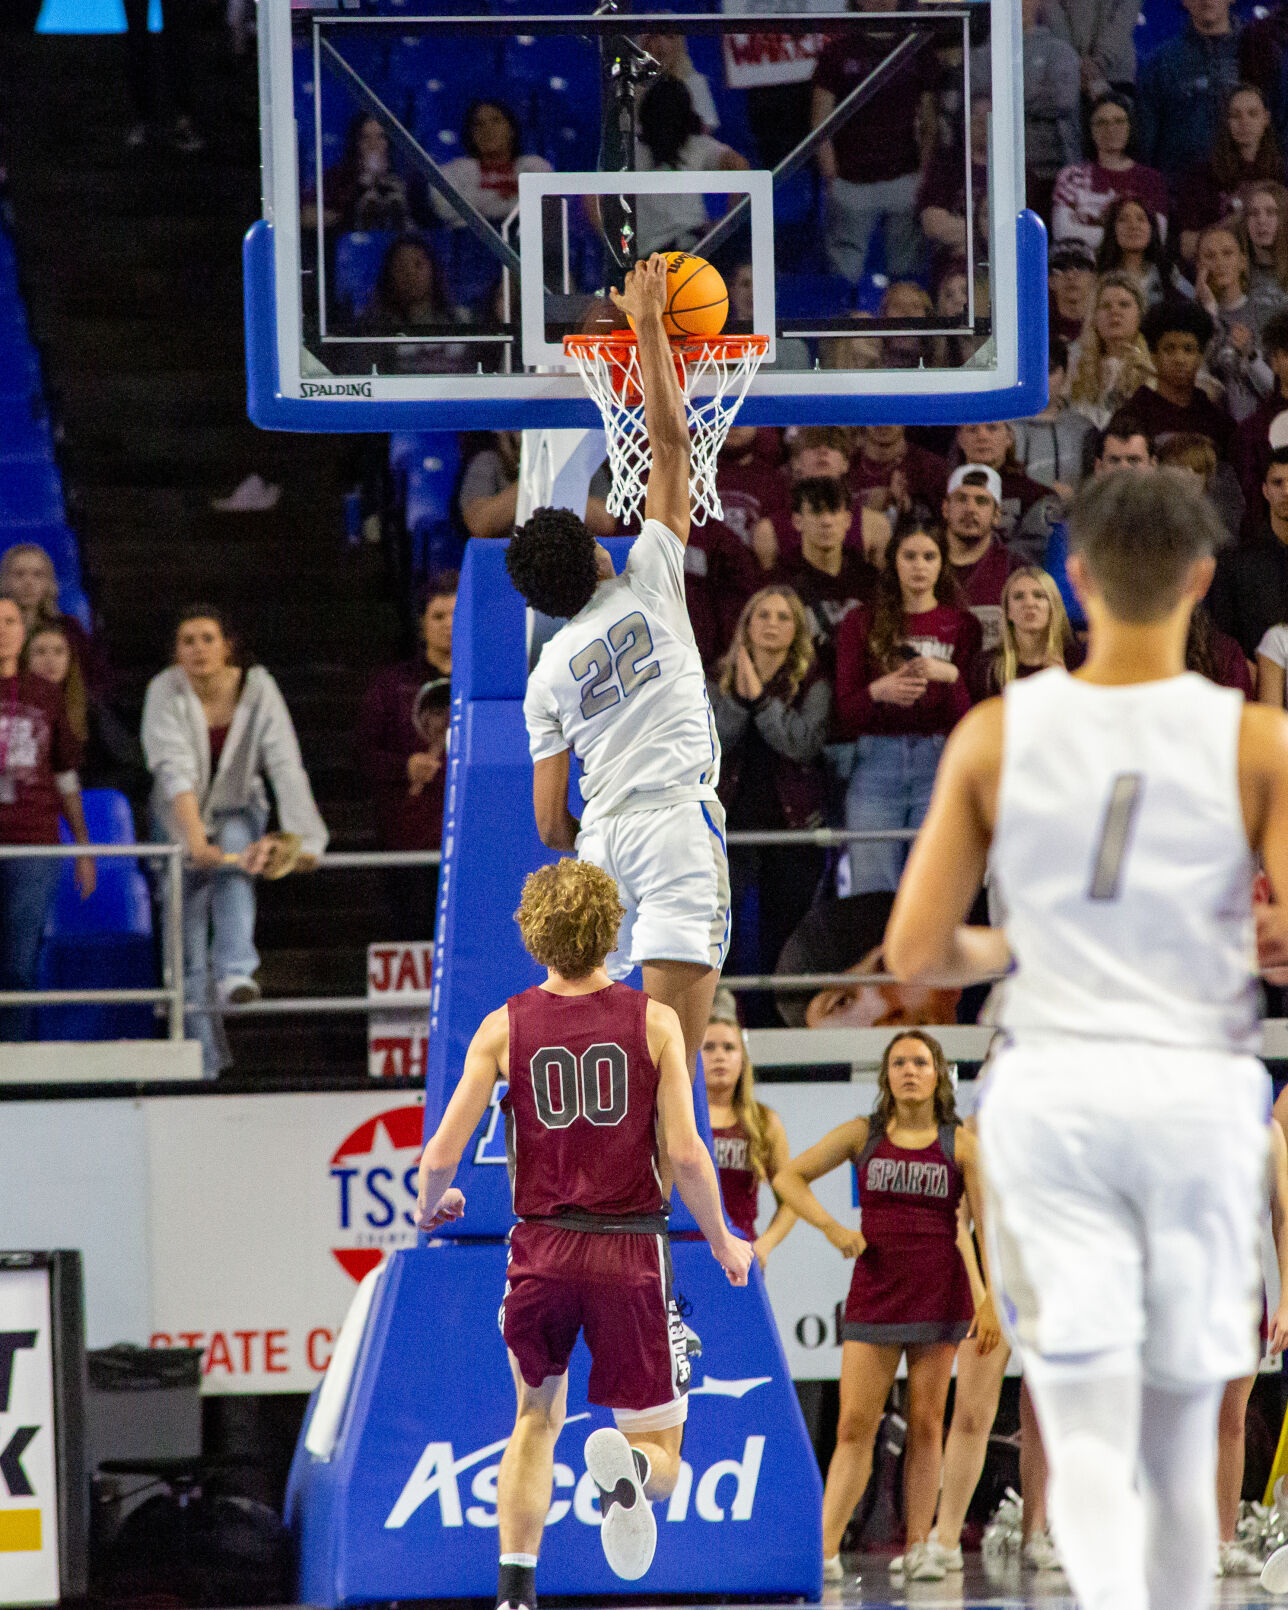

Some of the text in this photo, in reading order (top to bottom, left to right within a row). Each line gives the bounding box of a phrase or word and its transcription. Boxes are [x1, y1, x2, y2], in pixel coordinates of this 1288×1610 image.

[300, 382, 372, 398] SPALDING
[569, 611, 661, 720] 22
[1089, 772, 1142, 901] 1
[529, 1042, 628, 1129] 00
[867, 1158, 949, 1198] SPARTA
